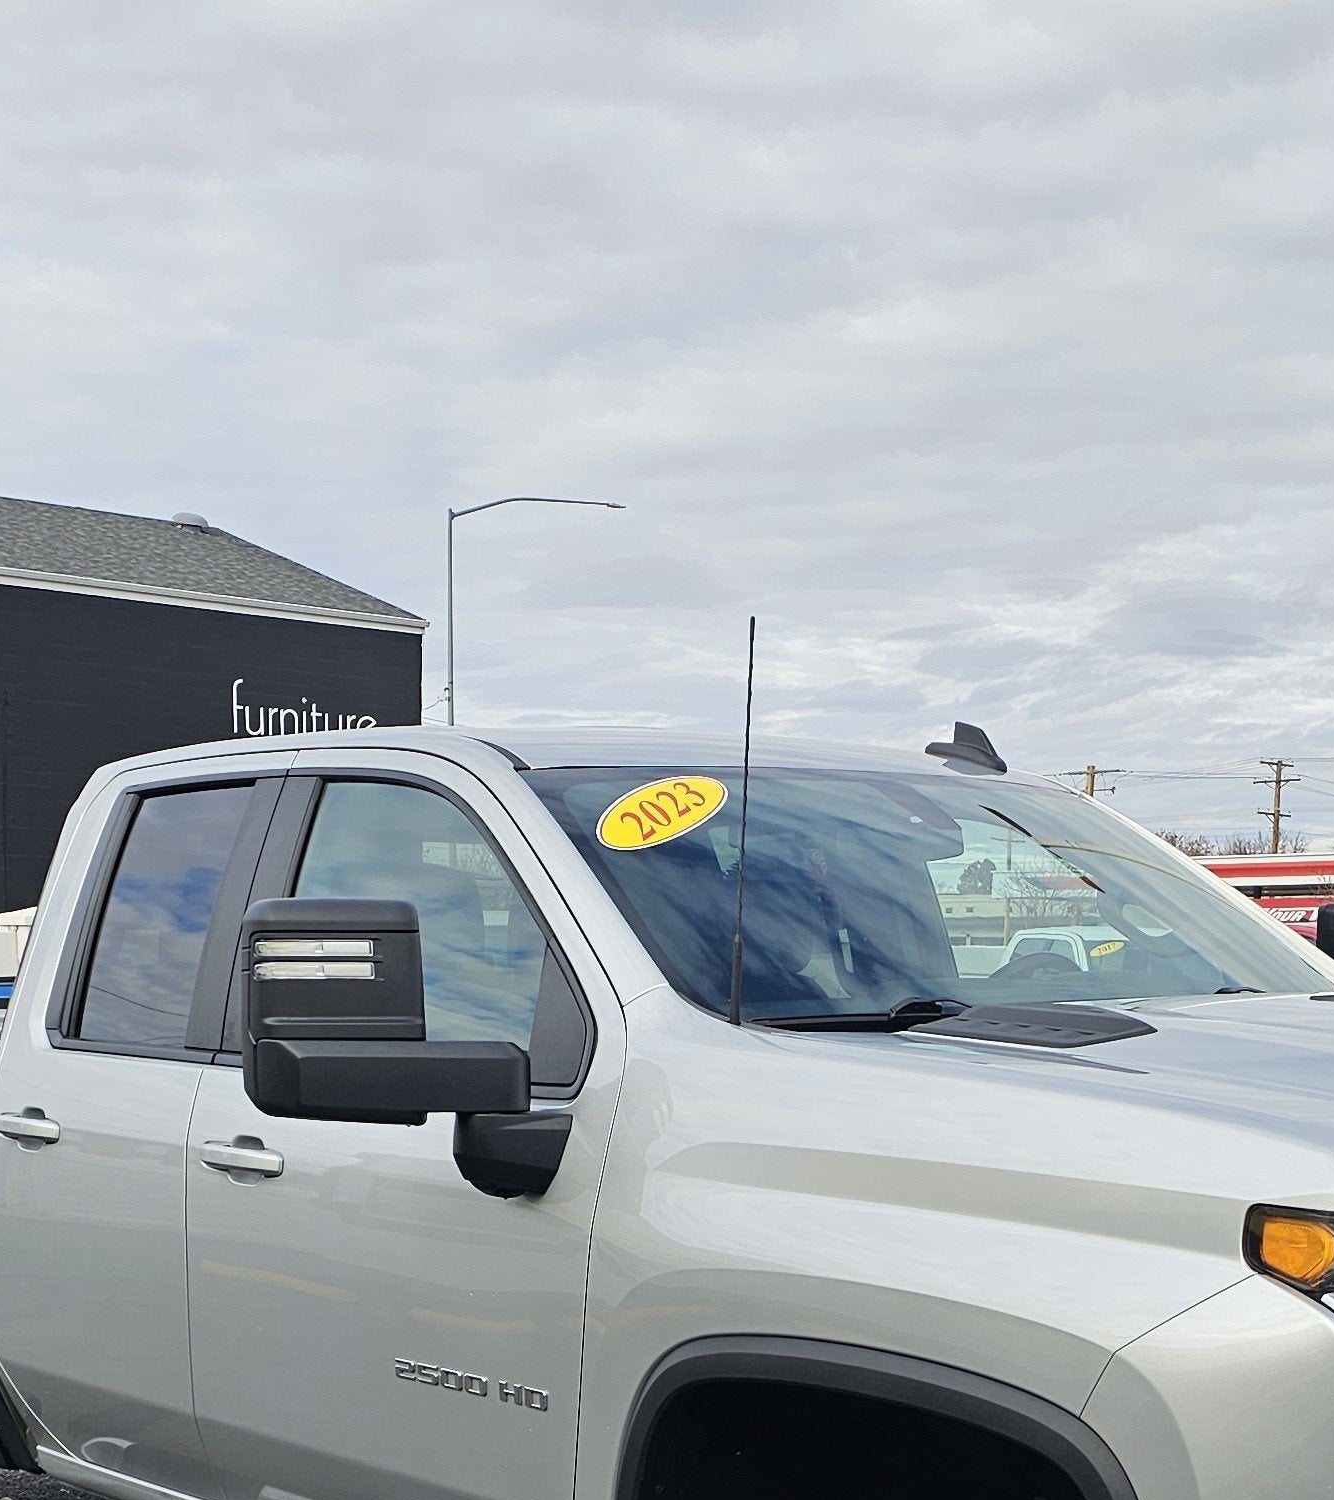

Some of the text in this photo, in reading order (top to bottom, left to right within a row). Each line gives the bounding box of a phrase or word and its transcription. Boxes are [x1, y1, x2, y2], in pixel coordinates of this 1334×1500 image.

[232, 679, 377, 736] furniture
[620, 781, 707, 842] 2023
[394, 1357, 549, 1411] 2500 HD
